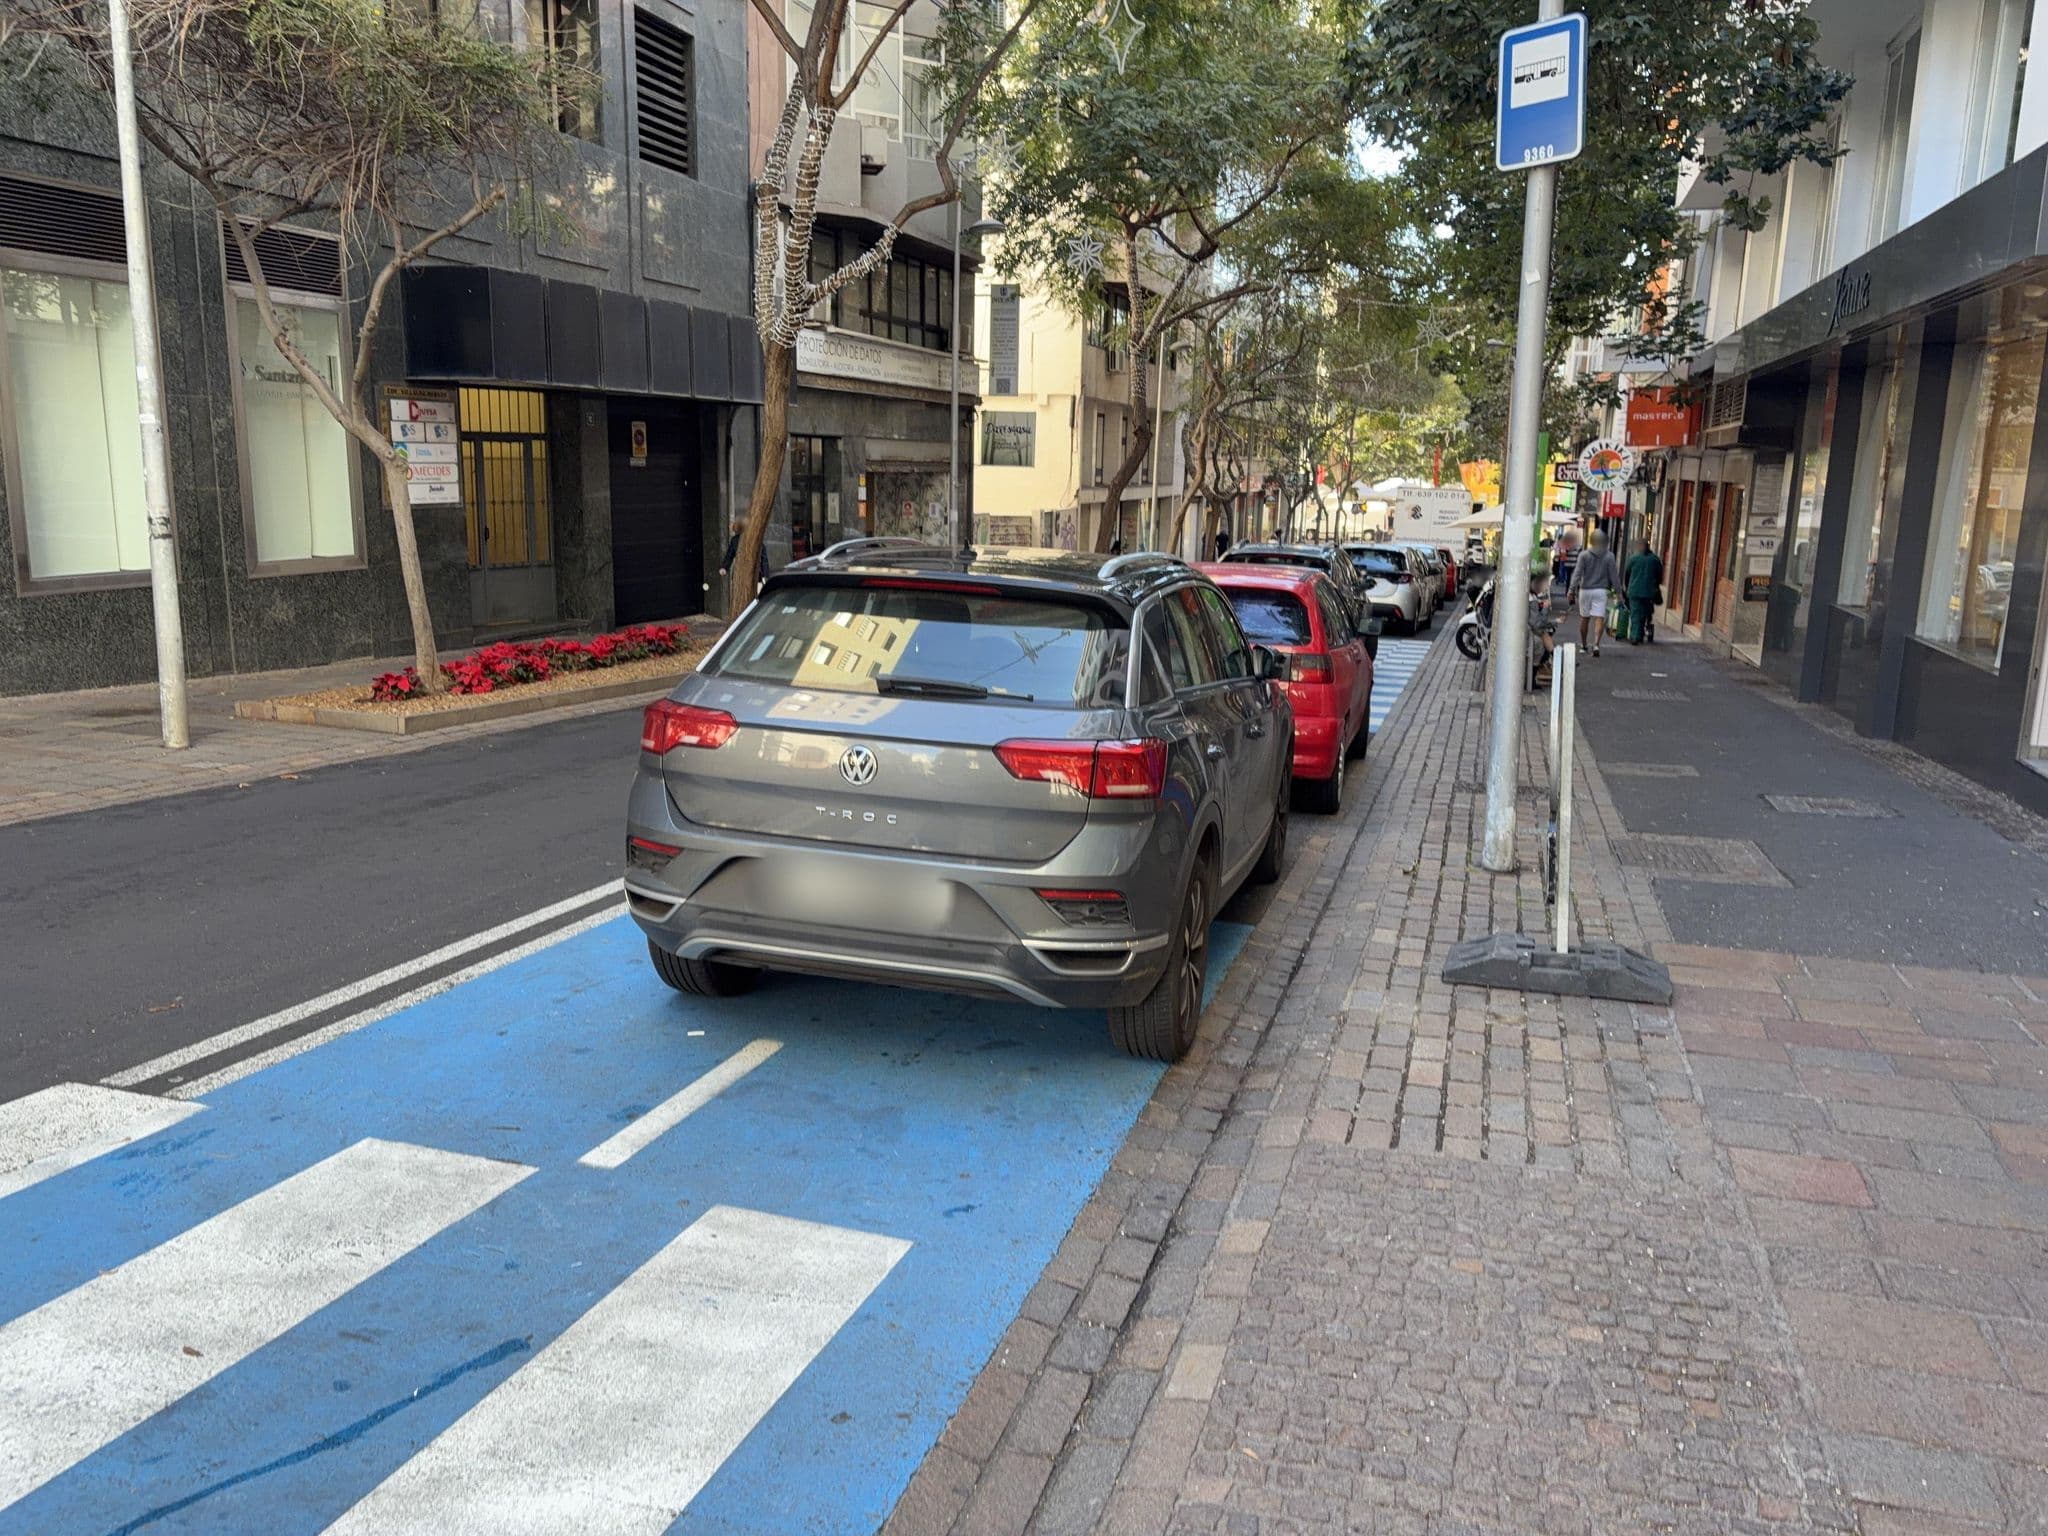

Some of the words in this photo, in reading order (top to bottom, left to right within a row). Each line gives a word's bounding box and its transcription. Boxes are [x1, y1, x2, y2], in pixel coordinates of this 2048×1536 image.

[799, 336, 848, 357] PROTECCIÓN
[849, 344, 859, 360] DE
[860, 347, 882, 364] DATOS
[815, 806, 897, 824] T-ROC
